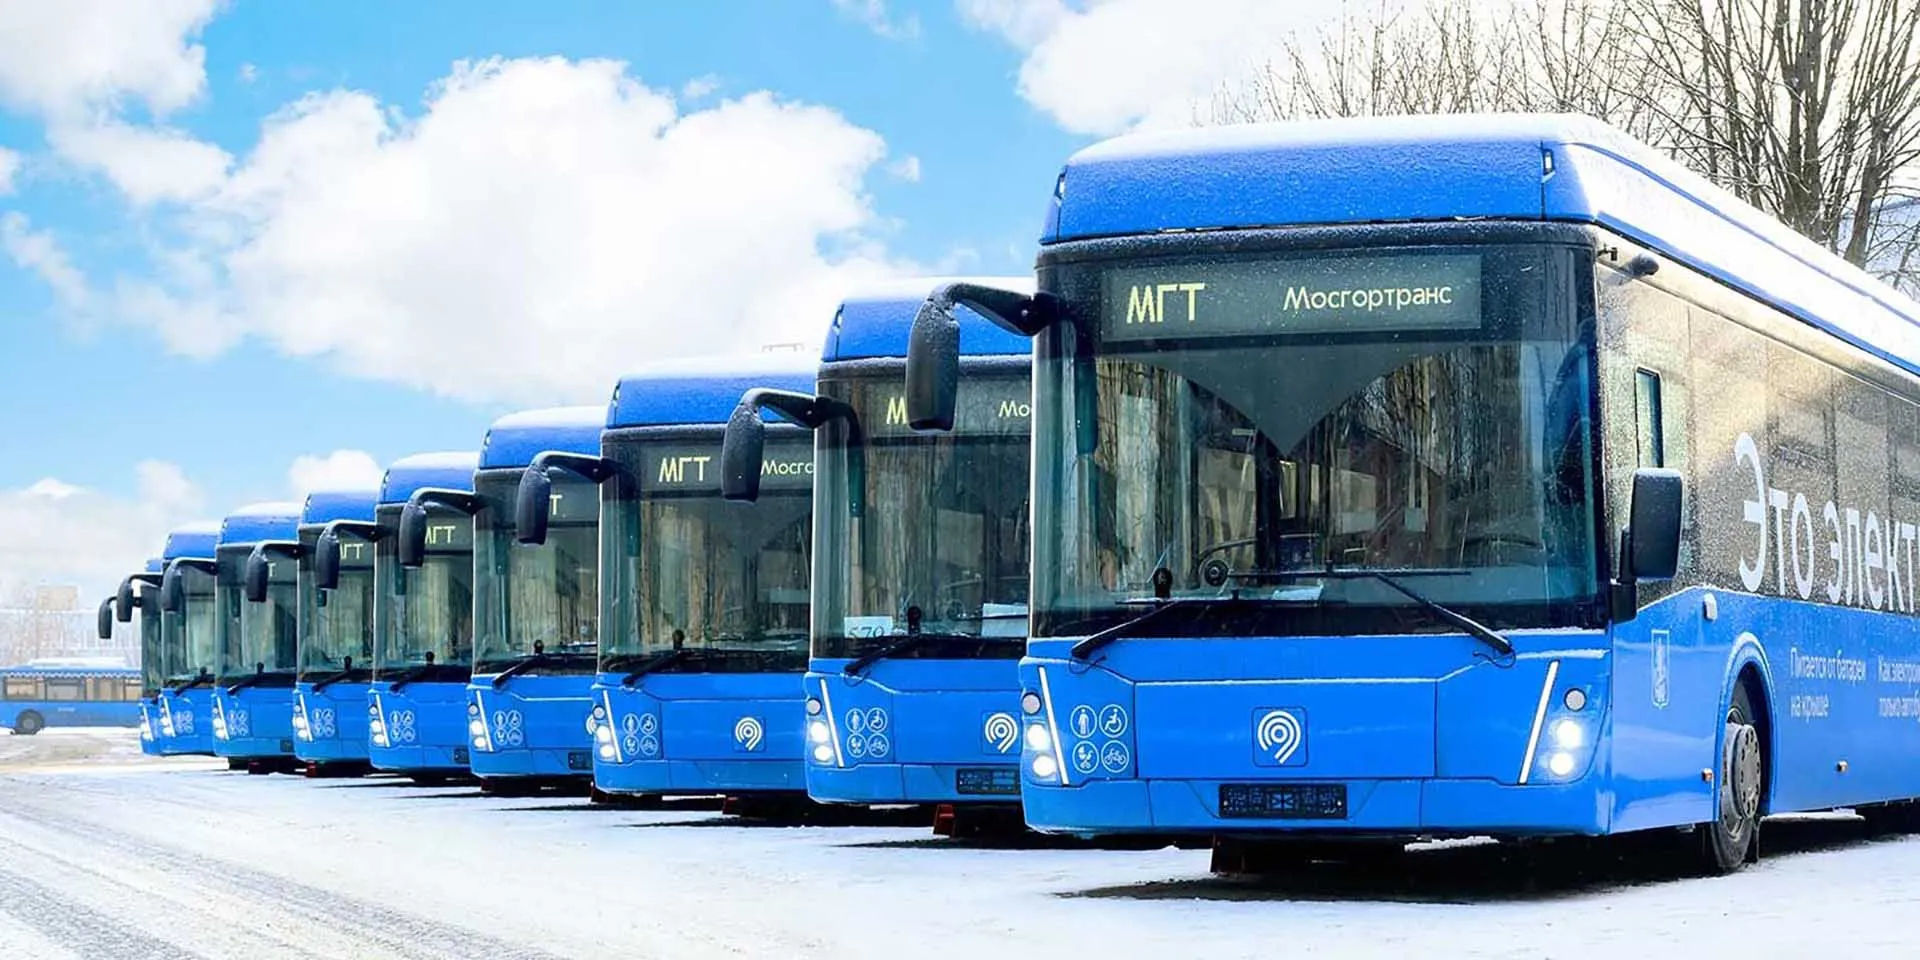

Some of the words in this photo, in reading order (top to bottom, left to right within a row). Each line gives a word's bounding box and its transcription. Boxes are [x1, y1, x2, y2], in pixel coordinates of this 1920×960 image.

[1126, 282, 1206, 324] МГТ
[1283, 285, 1453, 312] Мосгортранс
[658, 456, 711, 483] МГТ
[1735, 432, 1815, 600] Это
[1824, 500, 1920, 613] элект
